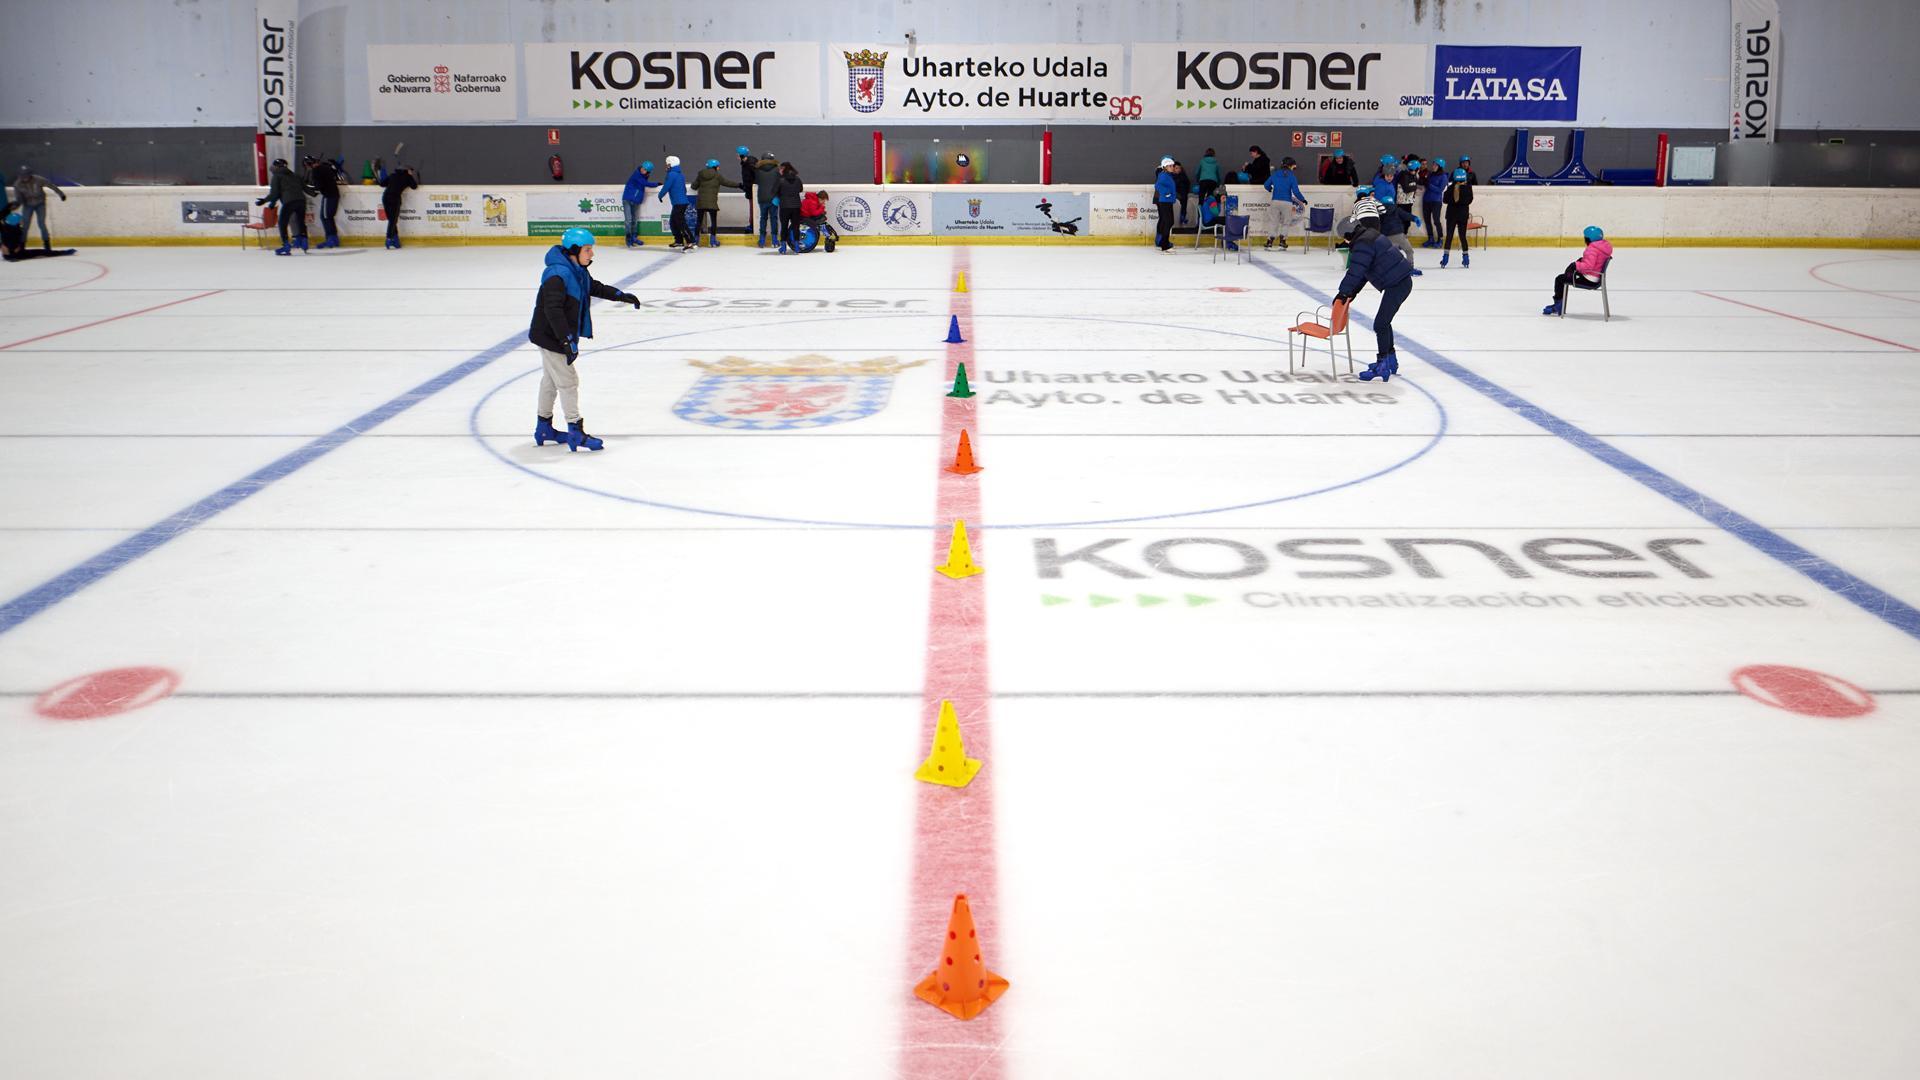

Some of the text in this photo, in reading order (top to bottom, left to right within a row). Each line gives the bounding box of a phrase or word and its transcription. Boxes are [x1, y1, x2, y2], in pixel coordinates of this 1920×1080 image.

[902, 56, 1108, 77] Uharteko Udala
[1446, 65, 1497, 74] Autobuses
[387, 74, 431, 83] Gobierno
[454, 74, 507, 83] Nafarroako
[379, 85, 431, 93] de Navarra
[454, 84, 501, 93] Gobernua
[1445, 78, 1568, 101] LATASA
[619, 96, 777, 110] Climatización eficiente
[903, 87, 1108, 112] Ayto. de Huarte
[1222, 97, 1379, 110] Climatización eficiente
[1109, 96, 1142, 117] SOS
[1511, 166, 1529, 174] CHH
[842, 209, 863, 218] CHH
[983, 370, 1360, 384] Uharteko Udala
[985, 390, 1399, 408] Ayto. de Huarte
[1242, 590, 1811, 610] Climatización eficiente
